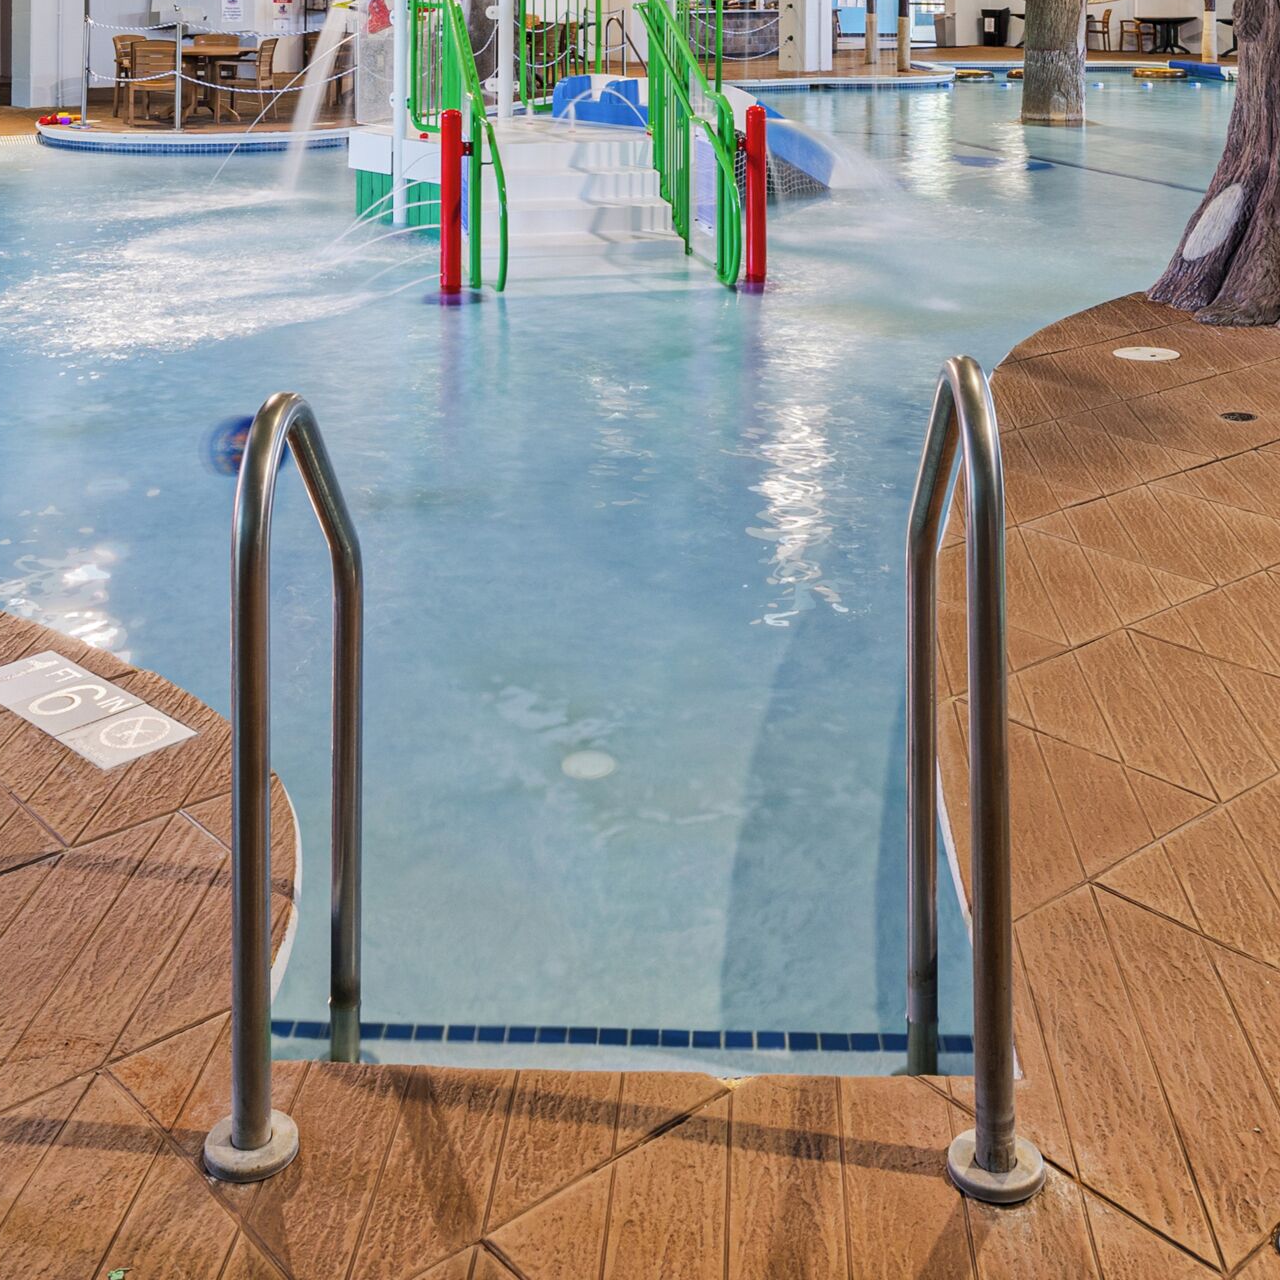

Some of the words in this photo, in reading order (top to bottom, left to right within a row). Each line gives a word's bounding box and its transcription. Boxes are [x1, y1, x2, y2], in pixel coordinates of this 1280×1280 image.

[46, 667, 84, 683] FT
[28, 683, 108, 716] 6
[98, 695, 135, 714] IN
